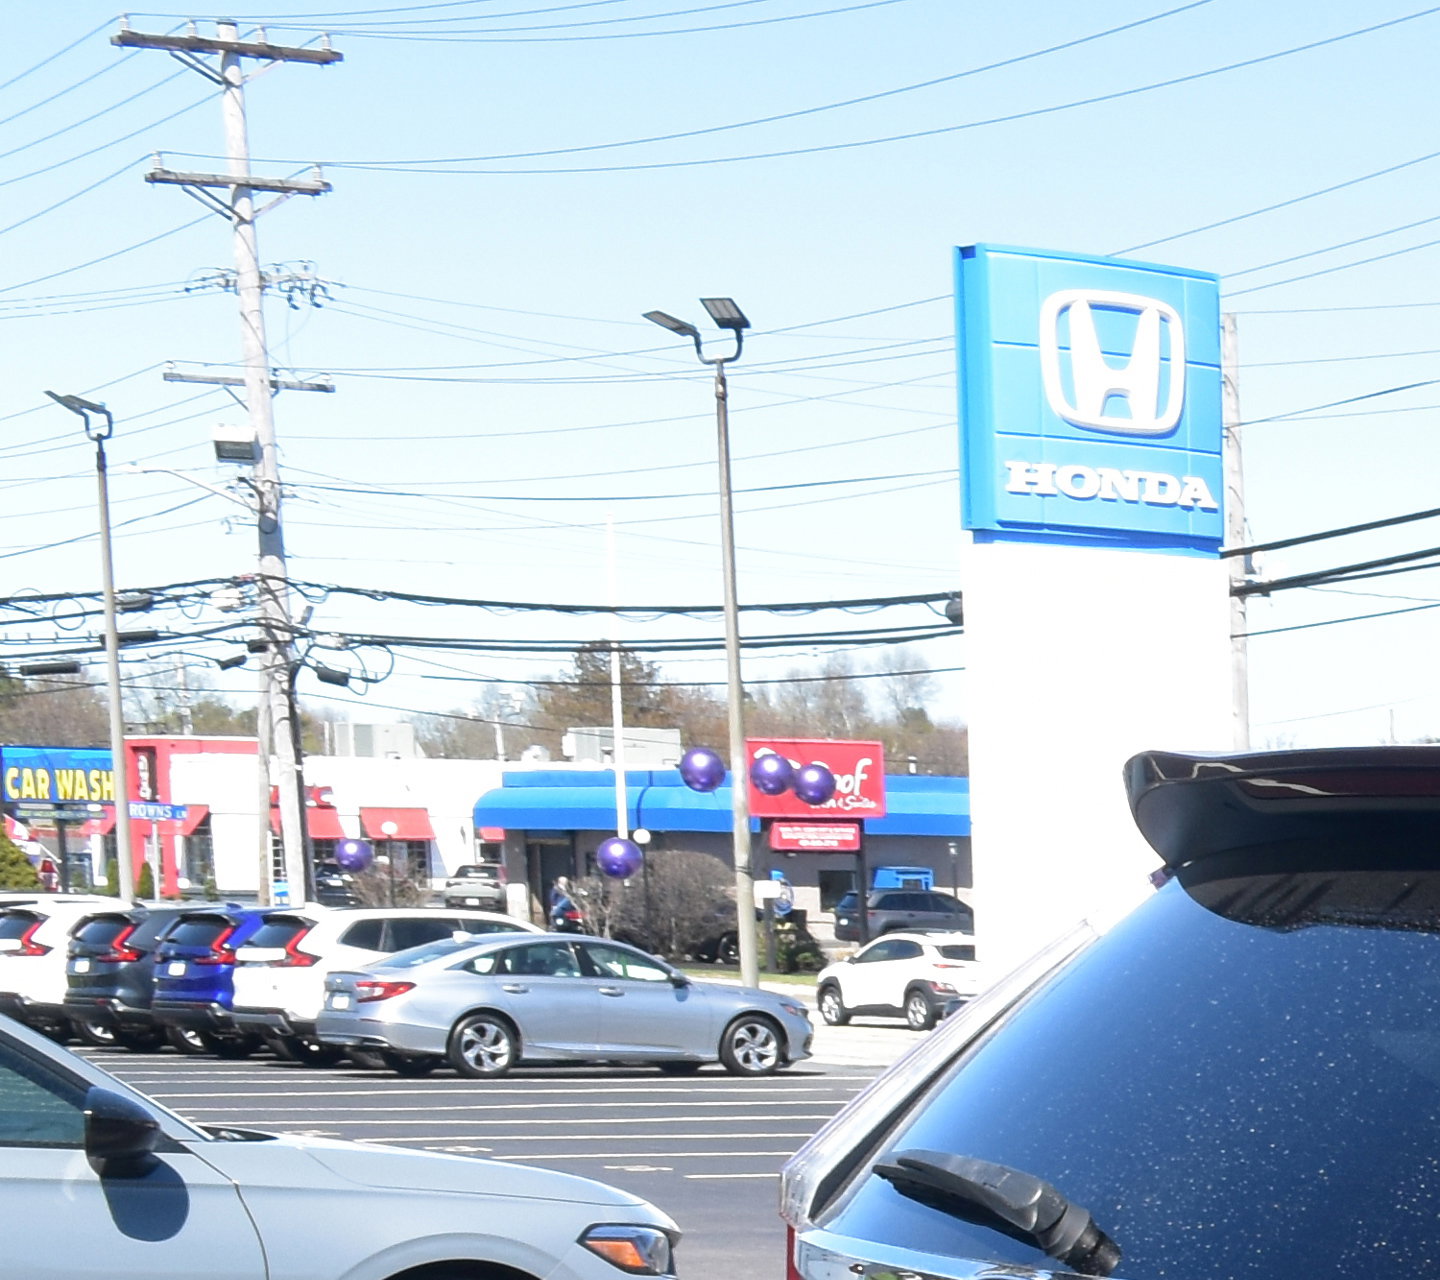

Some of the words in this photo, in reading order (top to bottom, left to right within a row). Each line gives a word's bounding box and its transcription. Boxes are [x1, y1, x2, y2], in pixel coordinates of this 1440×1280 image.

[1005, 462, 1218, 511] HONDA
[6, 767, 50, 799] CAR
[55, 769, 115, 801] WASH
[128, 803, 173, 818] ROWNS
